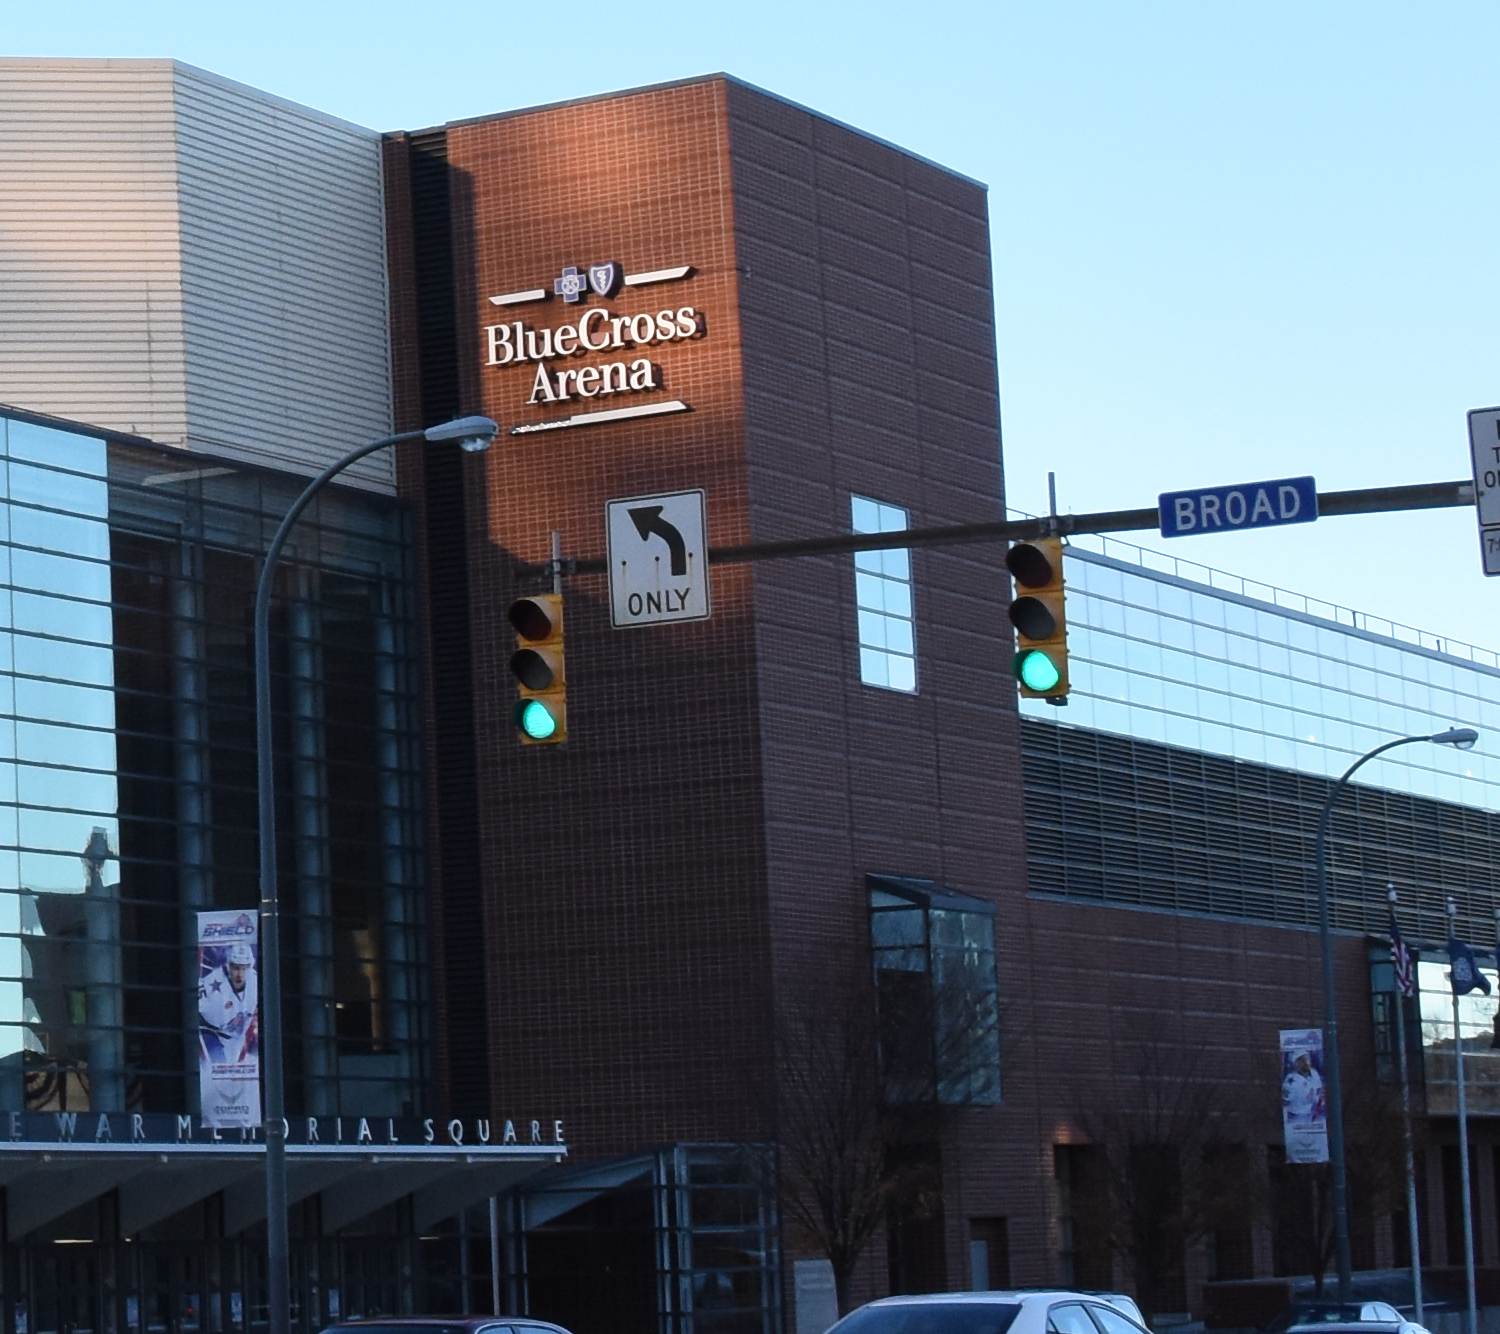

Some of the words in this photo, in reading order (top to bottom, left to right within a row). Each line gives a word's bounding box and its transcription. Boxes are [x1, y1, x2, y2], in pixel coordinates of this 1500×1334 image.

[483, 306, 698, 366] BlueCross
[526, 358, 656, 405] Arena
[1174, 485, 1301, 531] BROAD
[628, 587, 691, 616] ONLY
[55, 1112, 145, 1139] WAR
[423, 1118, 564, 1145] SQUARE
